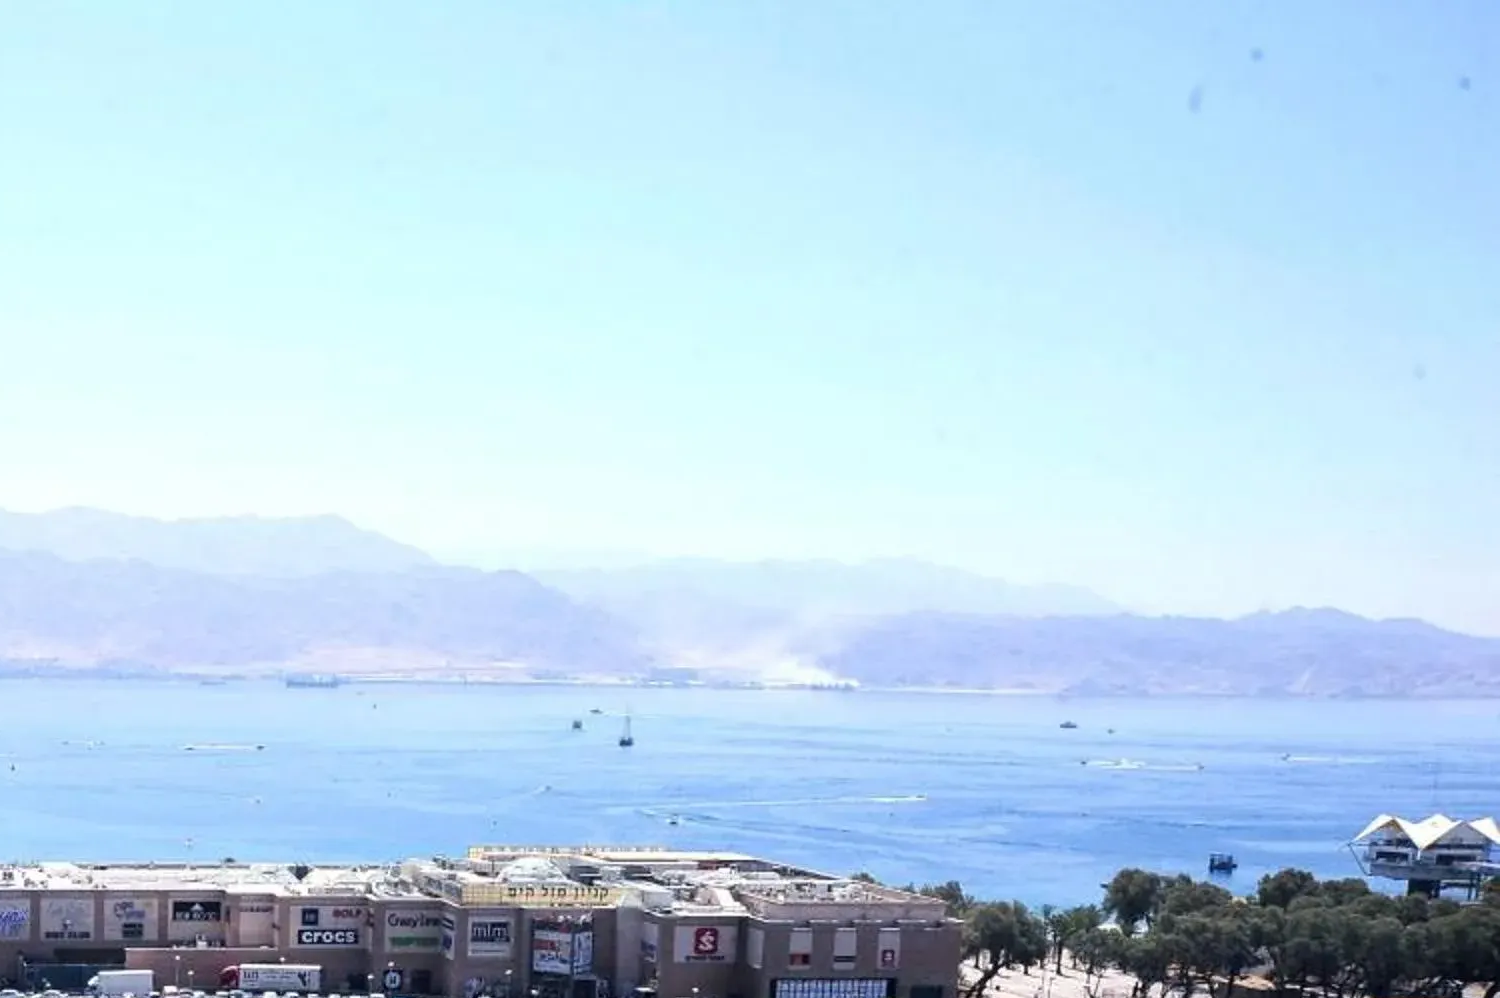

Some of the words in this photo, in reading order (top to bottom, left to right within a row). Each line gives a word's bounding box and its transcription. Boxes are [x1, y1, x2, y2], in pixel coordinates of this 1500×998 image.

[507, 887, 535, 900] הים
[541, 884, 567, 898] מול
[574, 887, 609, 901] קניון
[301, 931, 356, 944] crocs
